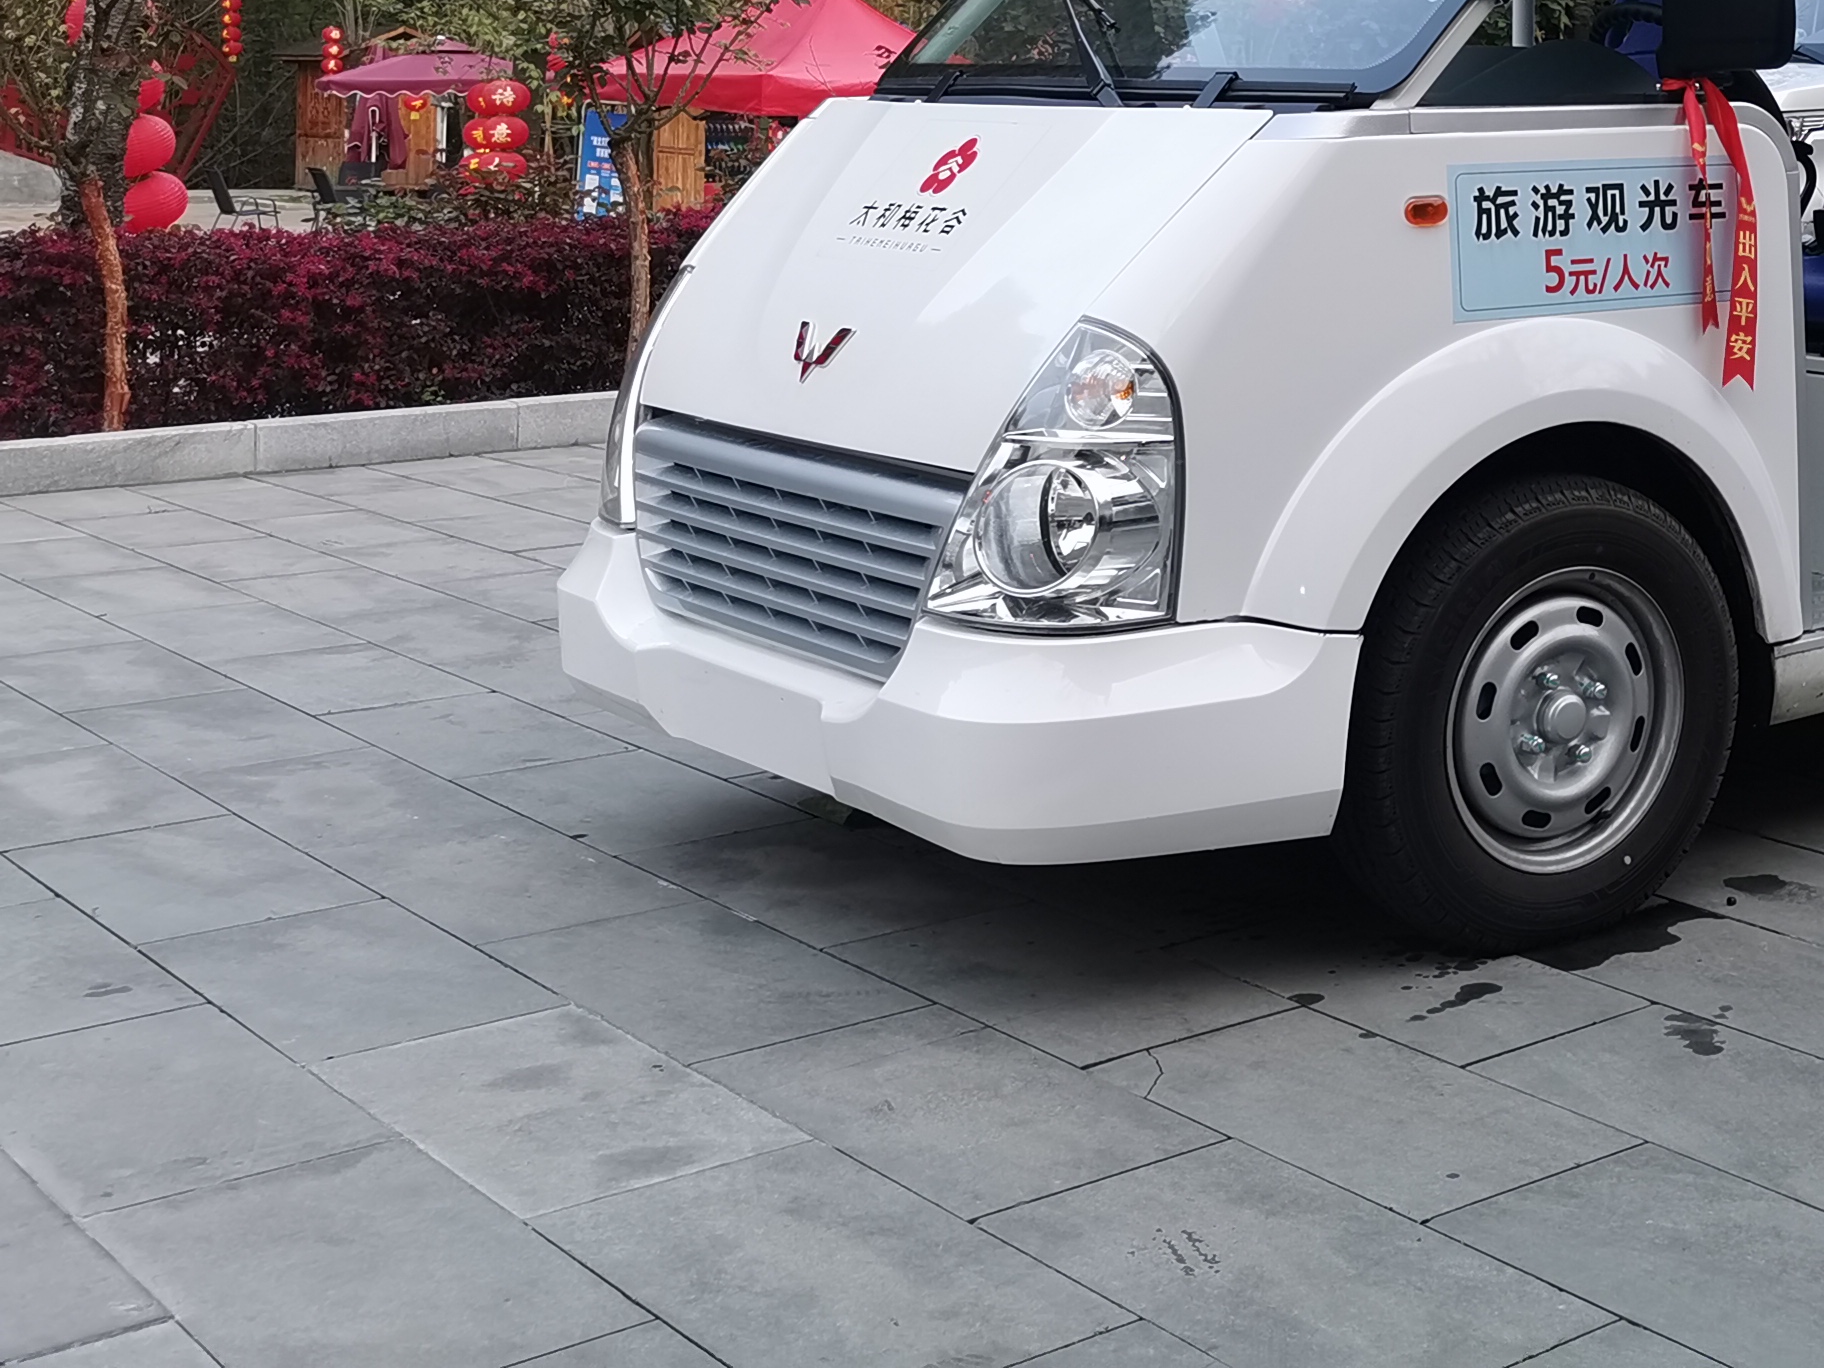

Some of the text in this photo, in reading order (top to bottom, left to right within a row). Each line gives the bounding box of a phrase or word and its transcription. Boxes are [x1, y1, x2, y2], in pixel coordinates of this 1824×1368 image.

[1473, 178, 1727, 242] 旅游观光车
[1543, 248, 1671, 296] 5元/人次
[1729, 230, 1756, 361] 出入平安
